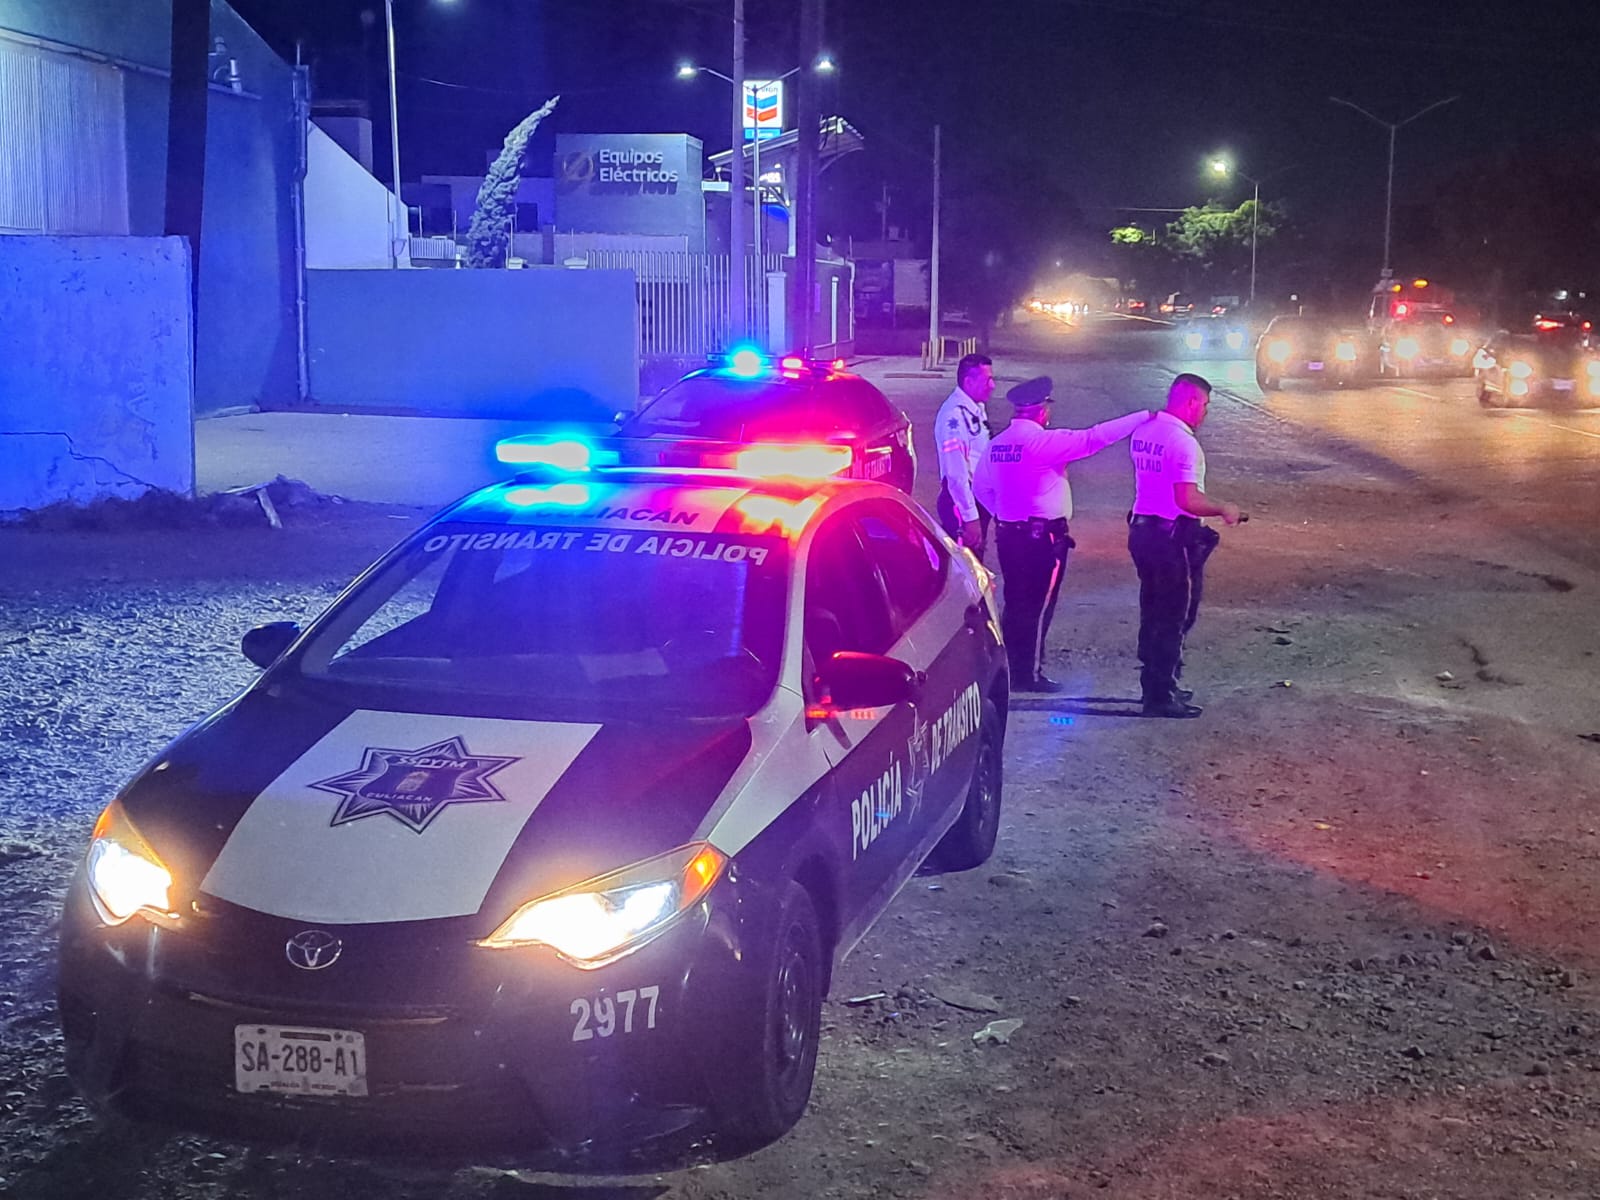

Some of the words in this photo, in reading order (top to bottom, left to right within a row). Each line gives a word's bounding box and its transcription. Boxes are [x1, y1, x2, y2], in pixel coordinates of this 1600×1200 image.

[600, 148, 664, 166] Equipos
[600, 166, 679, 182] Eléctricos
[851, 751, 902, 861] POLICÍA
[570, 985, 659, 1042] 2977
[241, 1041, 358, 1076] SA-288-A1
